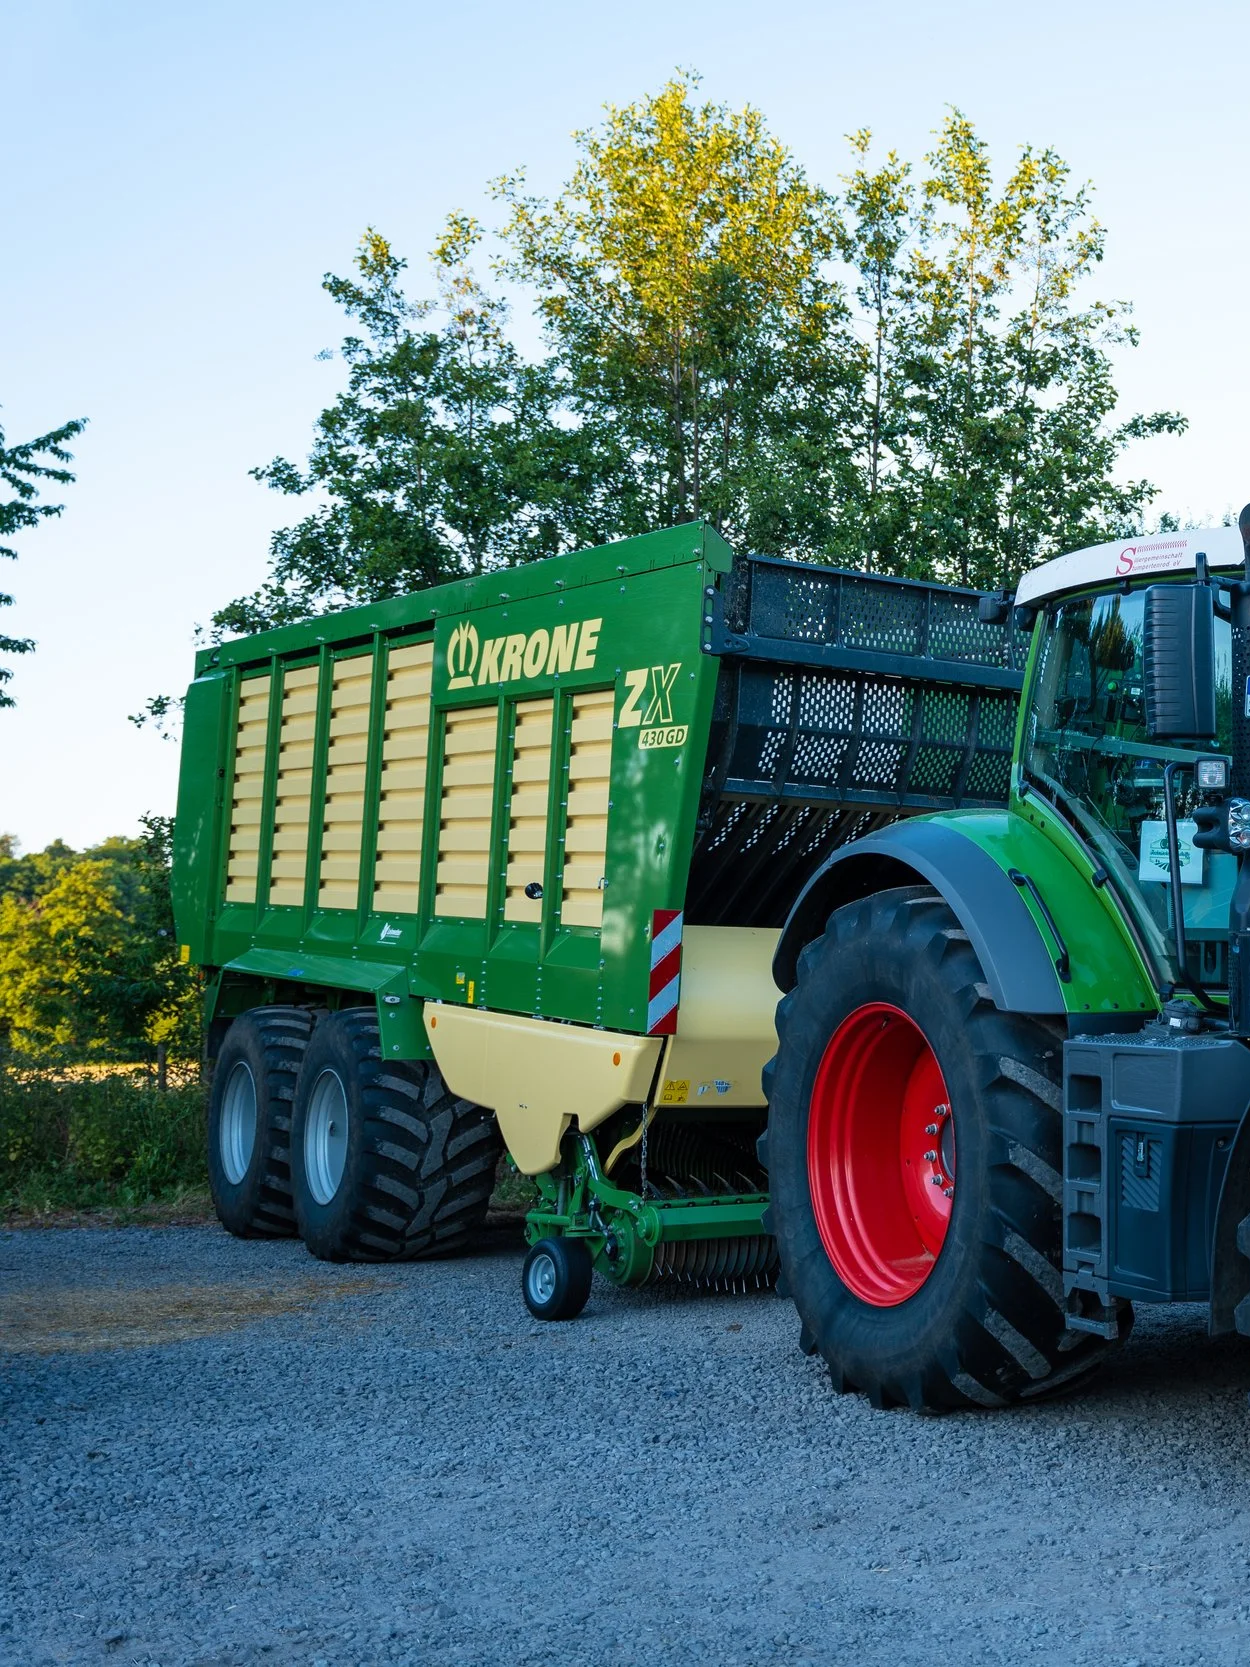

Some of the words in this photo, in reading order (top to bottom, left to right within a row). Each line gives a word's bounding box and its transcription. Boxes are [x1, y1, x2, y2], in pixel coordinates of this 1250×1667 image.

[477, 618, 603, 686] KRONE
[618, 663, 682, 729] ZX
[641, 730, 664, 747] 430
[665, 728, 685, 745] GD
